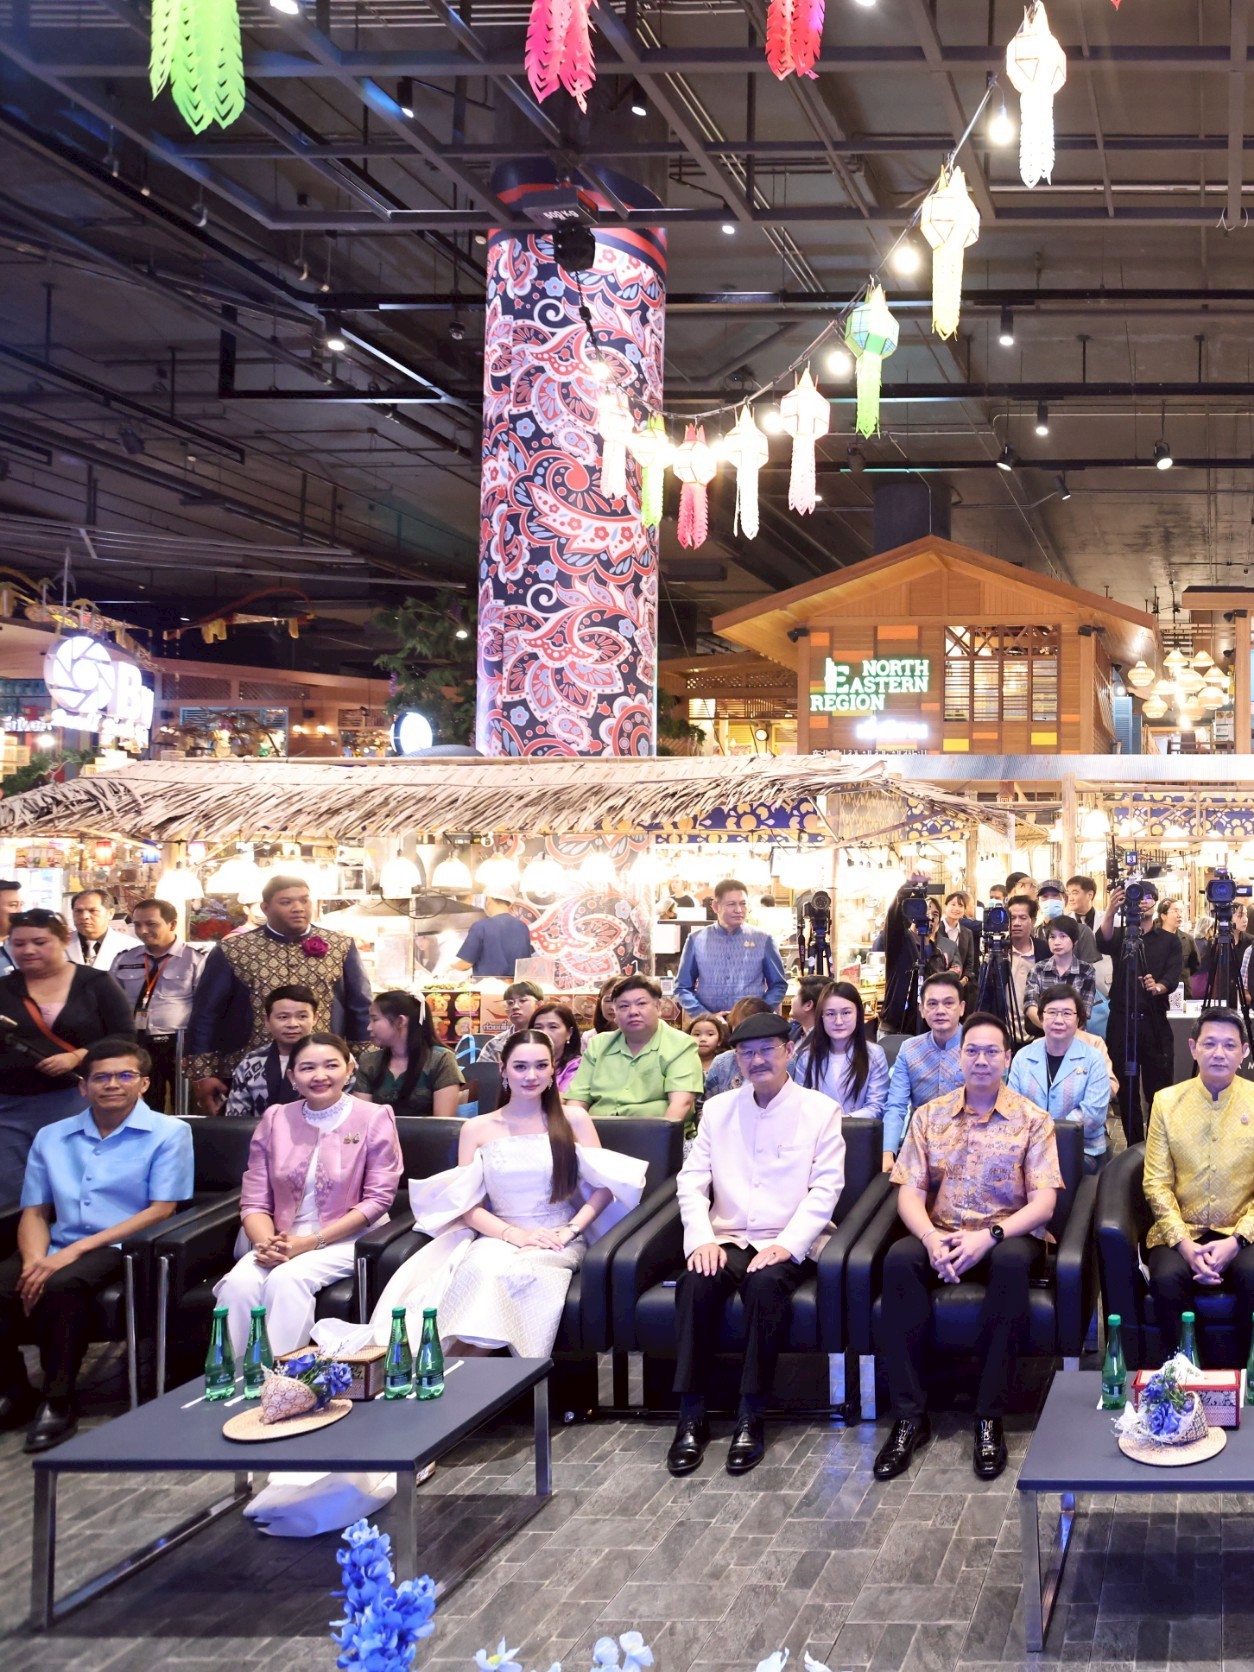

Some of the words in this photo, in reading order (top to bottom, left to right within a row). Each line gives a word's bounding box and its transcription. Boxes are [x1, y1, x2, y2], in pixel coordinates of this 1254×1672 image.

[824, 658, 929, 694] EASTERN
[862, 660, 929, 677] NORTH
[810, 694, 885, 711] REGION
